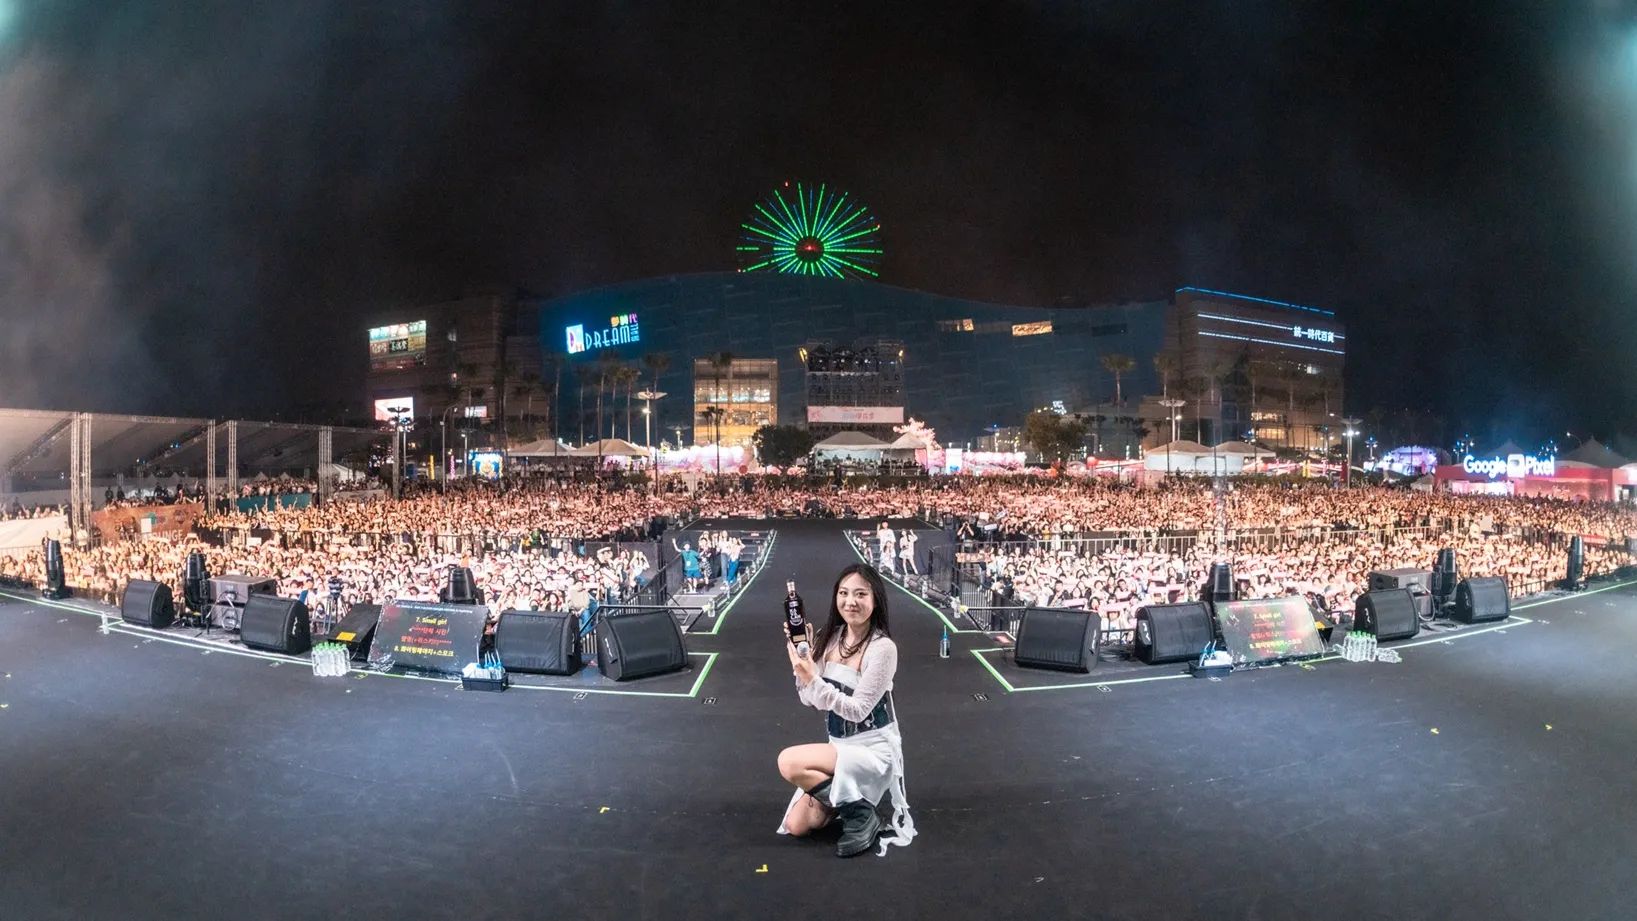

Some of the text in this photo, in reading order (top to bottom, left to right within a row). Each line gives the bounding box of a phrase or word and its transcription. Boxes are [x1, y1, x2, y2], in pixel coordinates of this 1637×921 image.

[585, 325, 630, 350] DREAM
[1463, 454, 1555, 479] Google Pixel
